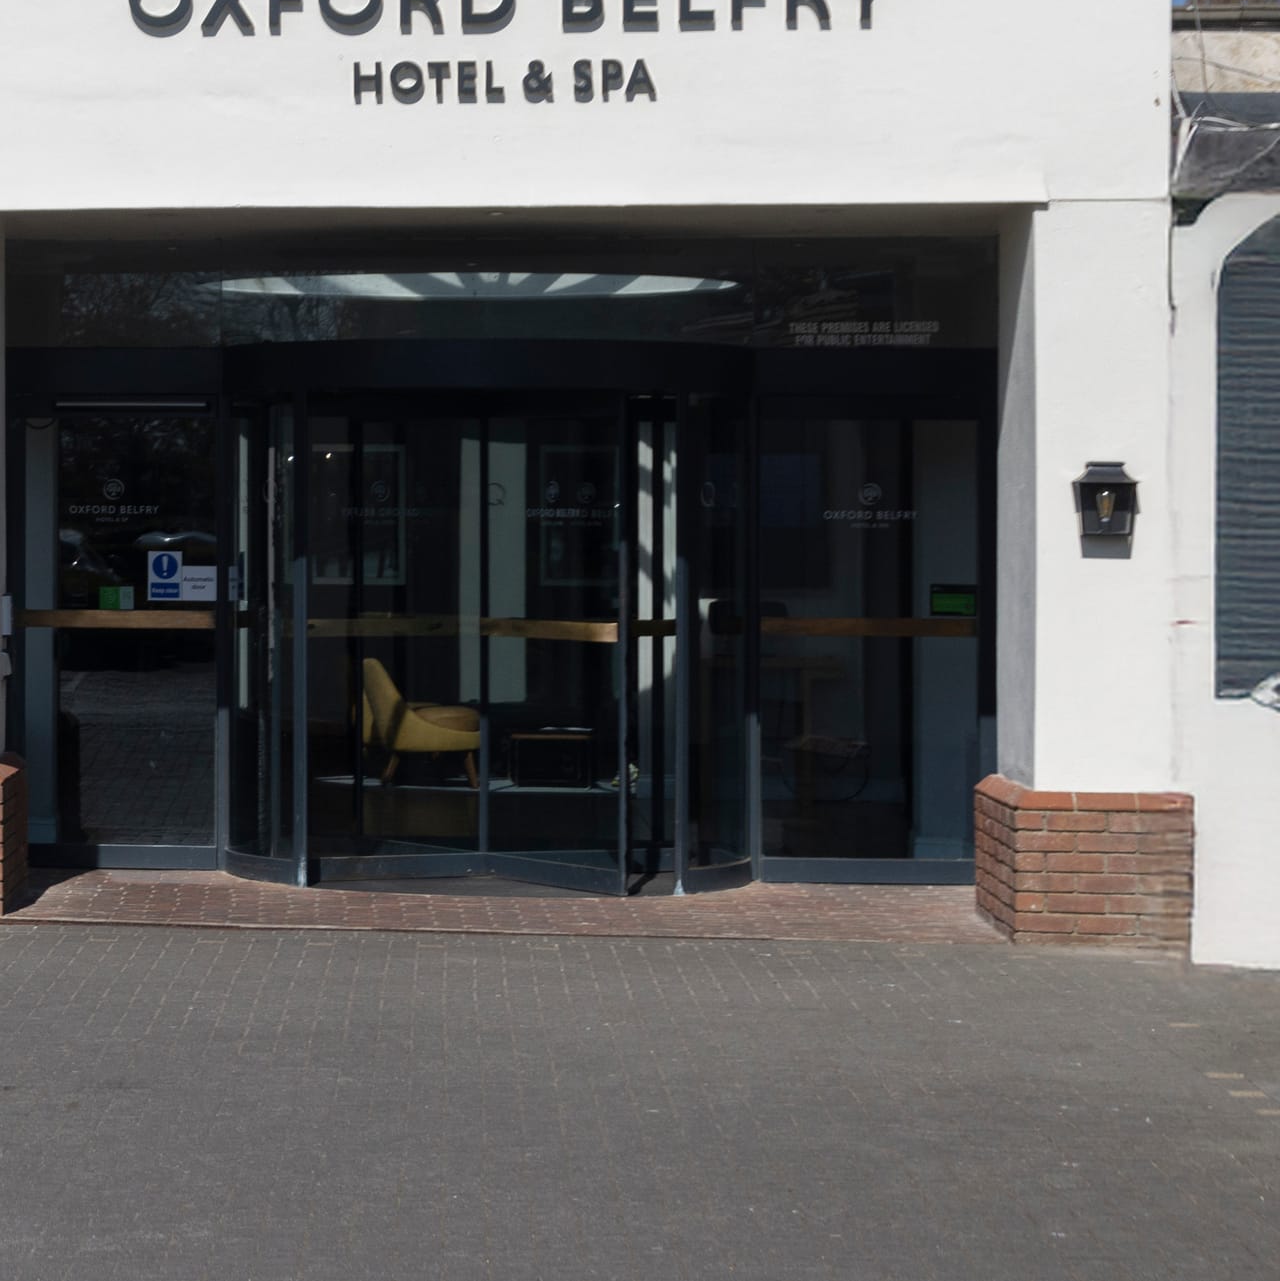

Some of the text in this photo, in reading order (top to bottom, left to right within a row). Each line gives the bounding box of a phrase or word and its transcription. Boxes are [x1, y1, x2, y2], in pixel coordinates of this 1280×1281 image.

[353, 58, 657, 105] HOTEL & SPA
[789, 321, 940, 333] THESE PREMISES ARE LICENSED
[795, 334, 932, 346] FOR PUBLIC ENTERTAINMENT
[68, 505, 160, 514] OXFORD BELFRY
[823, 510, 920, 520] OXFORD BELFRY
